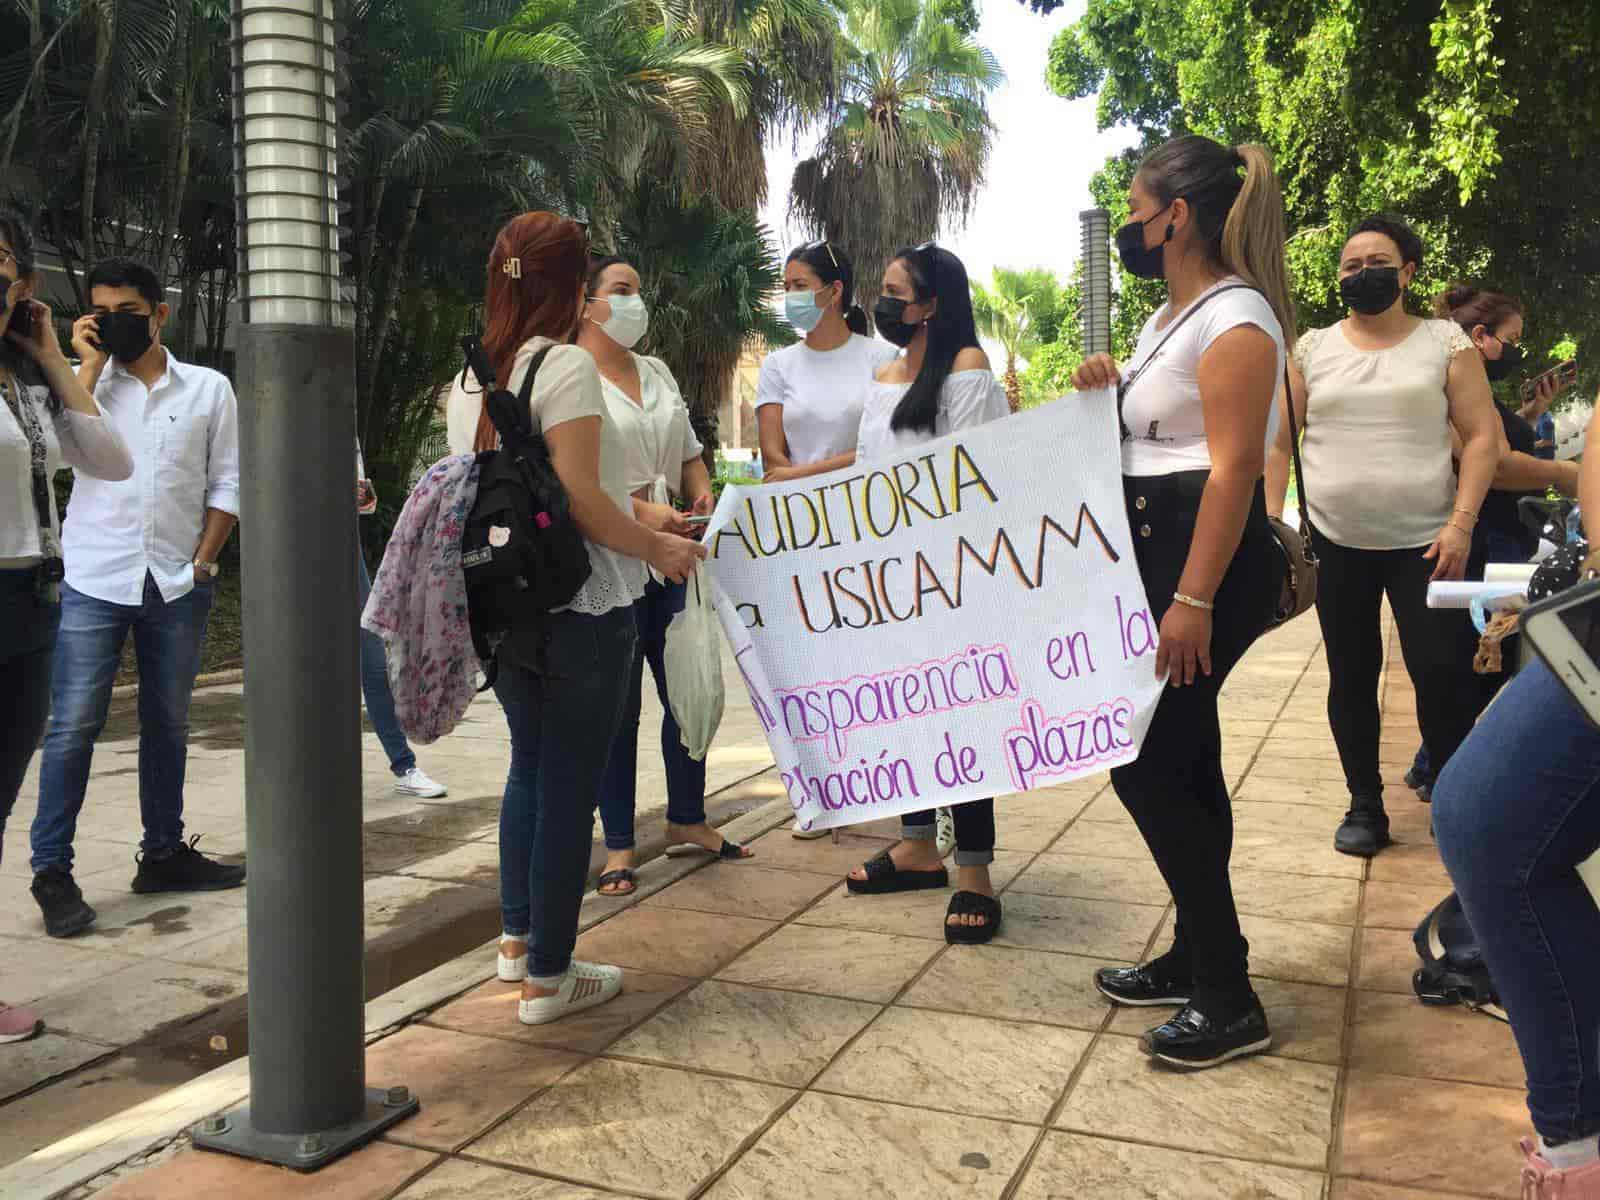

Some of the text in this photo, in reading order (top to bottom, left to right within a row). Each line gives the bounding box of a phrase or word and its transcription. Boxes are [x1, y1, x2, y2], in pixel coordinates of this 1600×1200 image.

[713, 444, 999, 560] AUDITORIA
[735, 502, 1121, 634] a USICAMM
[1046, 631, 1096, 680] en
[1114, 595, 1156, 661] la
[934, 732, 984, 789] de
[1009, 706, 1134, 790] plazas
